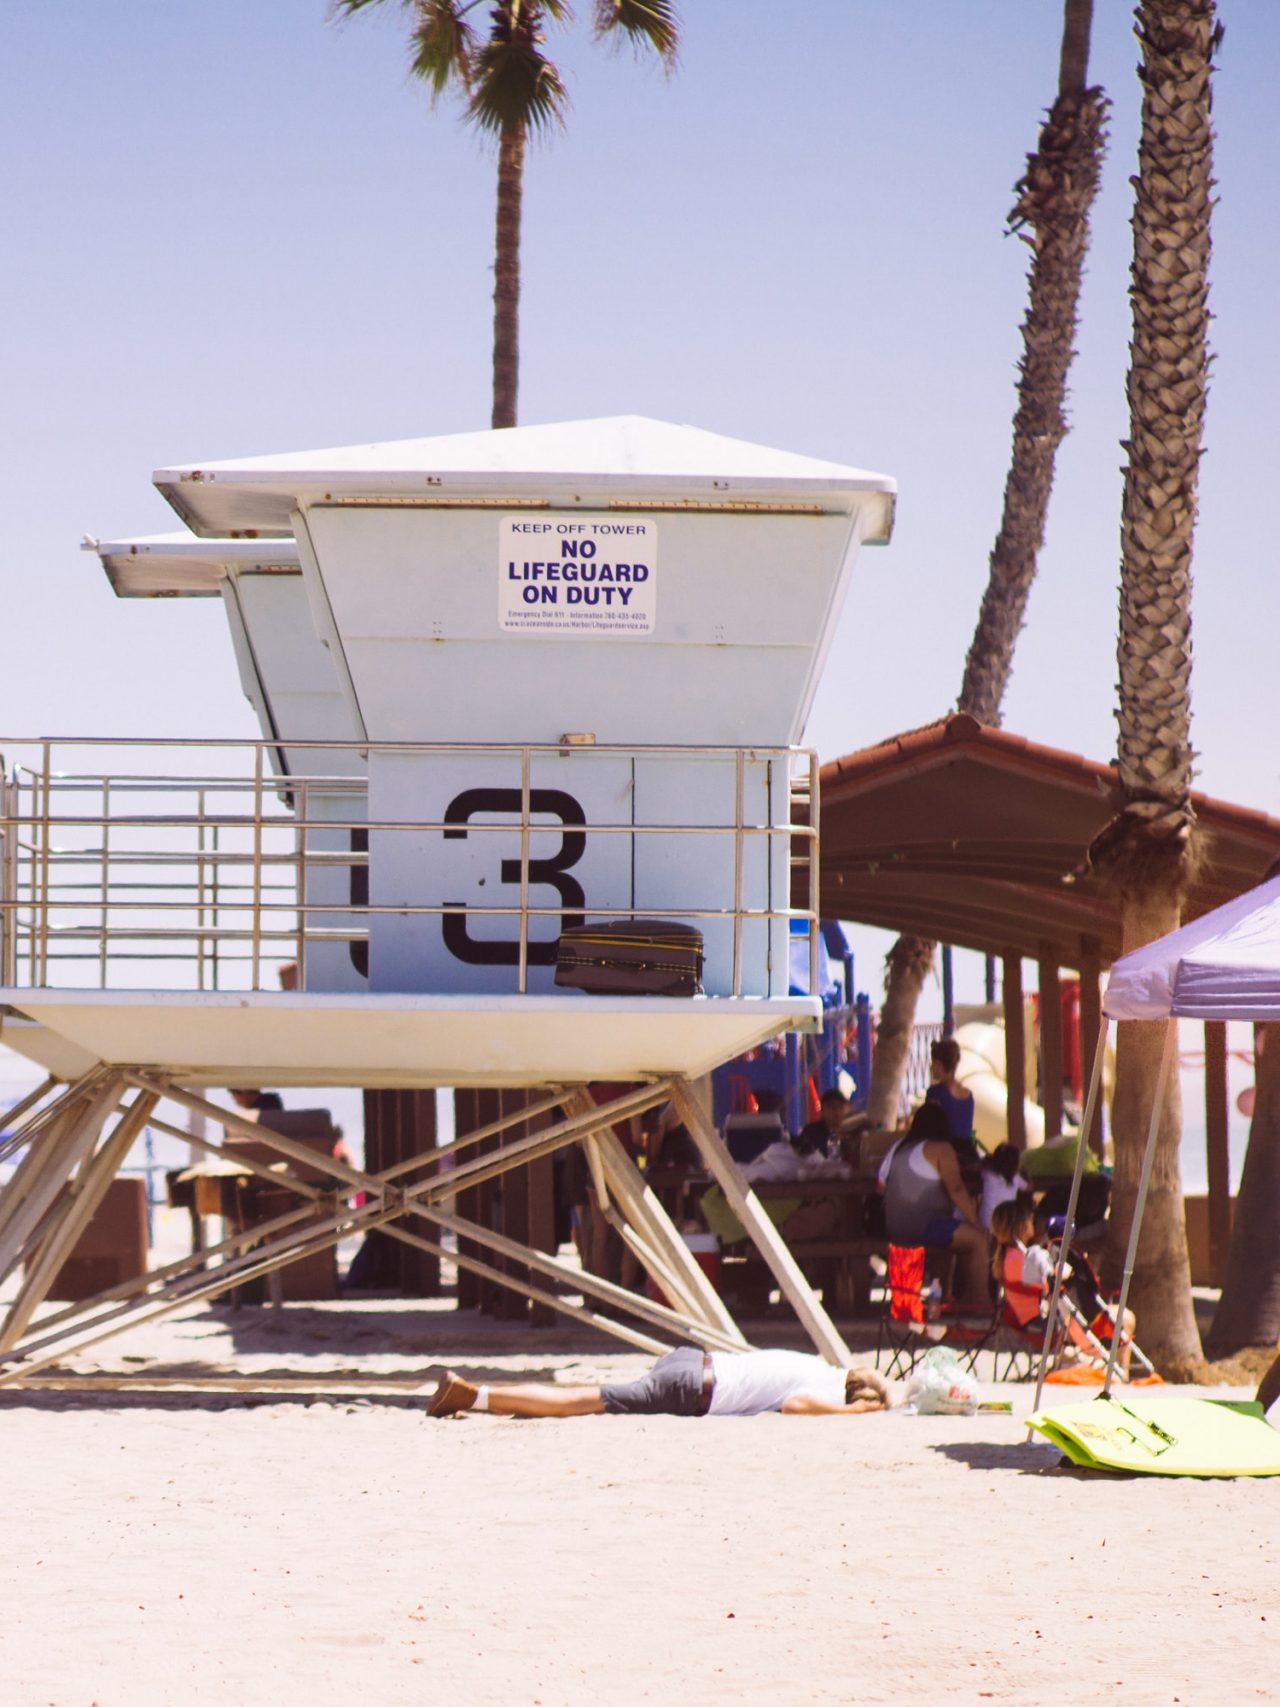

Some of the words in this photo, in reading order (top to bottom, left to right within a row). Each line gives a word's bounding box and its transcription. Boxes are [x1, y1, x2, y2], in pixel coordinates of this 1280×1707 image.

[511, 523, 552, 534] KEEP
[556, 524, 586, 534] OFF
[591, 525, 646, 535] TOWER
[561, 540, 597, 558] NO
[508, 562, 649, 582] LIFEGUARD
[522, 585, 558, 604] ON
[566, 586, 633, 605] DUTY
[508, 610, 540, 619] Emergency
[542, 610, 553, 618] Dial
[570, 611, 603, 619] Information
[442, 788, 586, 967] 3
